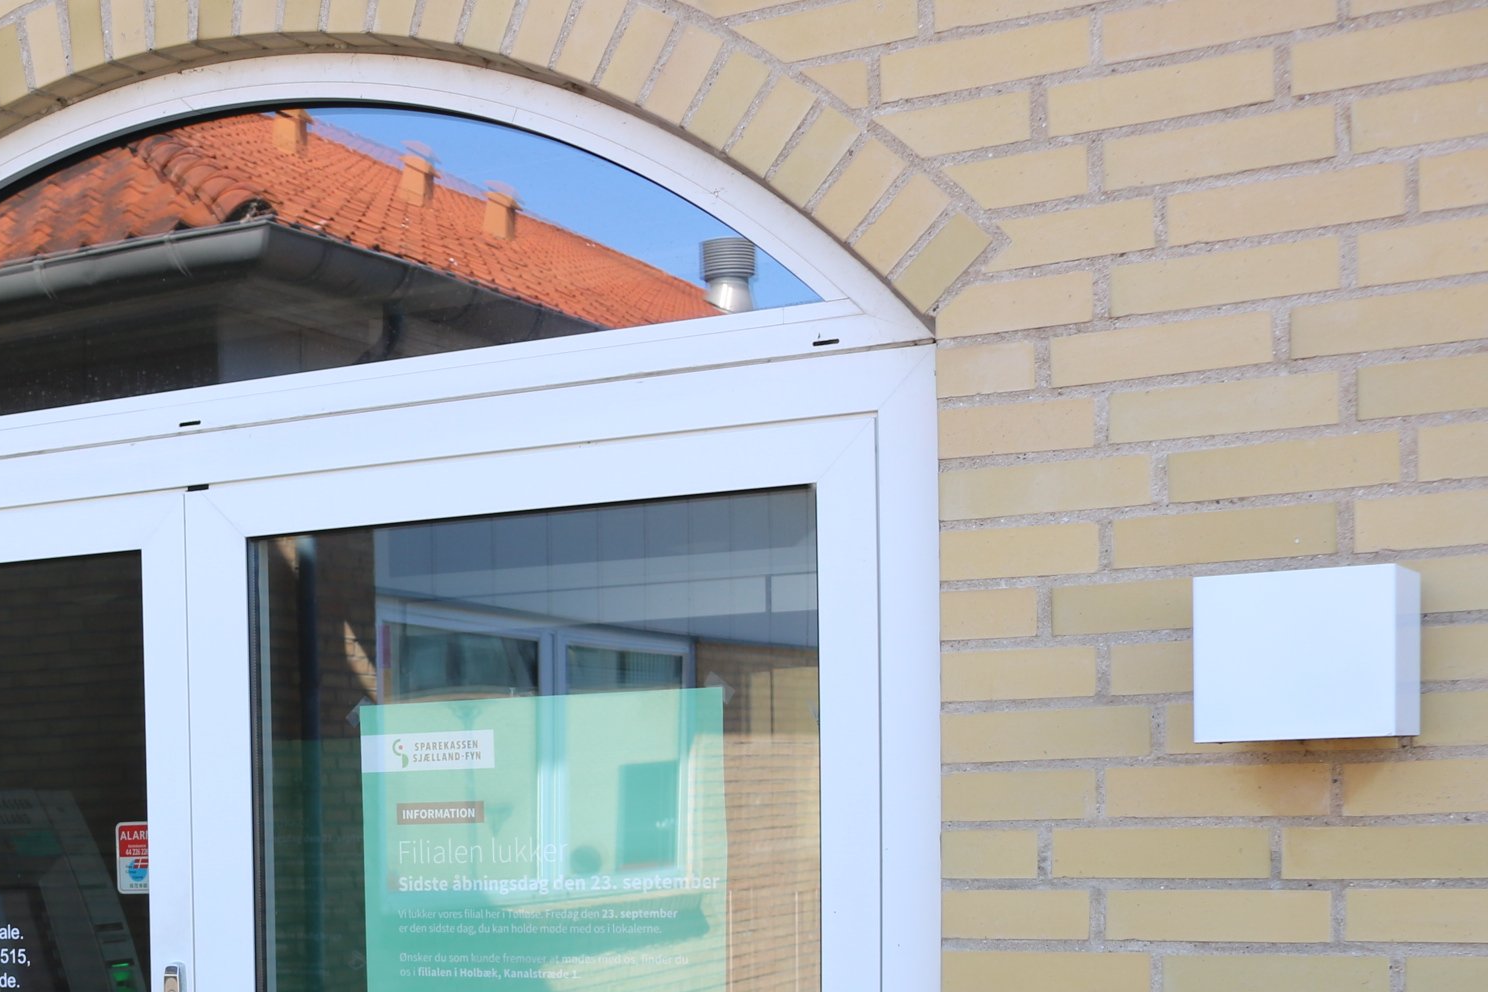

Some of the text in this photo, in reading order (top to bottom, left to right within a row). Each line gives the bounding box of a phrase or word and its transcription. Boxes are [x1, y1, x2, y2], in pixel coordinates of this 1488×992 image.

[414, 739, 479, 750] SPAREKASSEN
[412, 750, 482, 763] SJÆLLAND-FYN
[402, 807, 475, 820] INFORMATION
[398, 836, 568, 865] Filialen lukker
[398, 872, 720, 895] Sidste åbningsdag den 23. september
[398, 910, 408, 919] Vi
[408, 910, 436, 919] lukker
[438, 911, 463, 919] vores
[464, 909, 484, 919] filial
[486, 910, 500, 919] her
[546, 909, 580, 922] Fredag
[580, 910, 600, 919] den
[602, 910, 618, 919] 23.
[620, 909, 678, 921] september
[398, 926, 409, 934] er
[410, 924, 426, 934] den
[428, 924, 455, 934] sidste
[457, 924, 476, 936] dag,
[478, 924, 491, 934] du
[492, 924, 509, 934] kan
[511, 924, 538, 934] holde
[540, 924, 567, 934] møde
[570, 924, 592, 934] med
[594, 926, 606, 934] os
[612, 924, 662, 934] lokalerne.
[400, 952, 432, 962] Ønsker
[434, 952, 447, 962] du
[449, 954, 469, 962] som
[471, 952, 499, 963] kunde
[400, 968, 410, 976] os
[418, 967, 452, 977] filialen
[460, 968, 502, 980] Holbæk,
[504, 968, 568, 979] Kanalstræde
